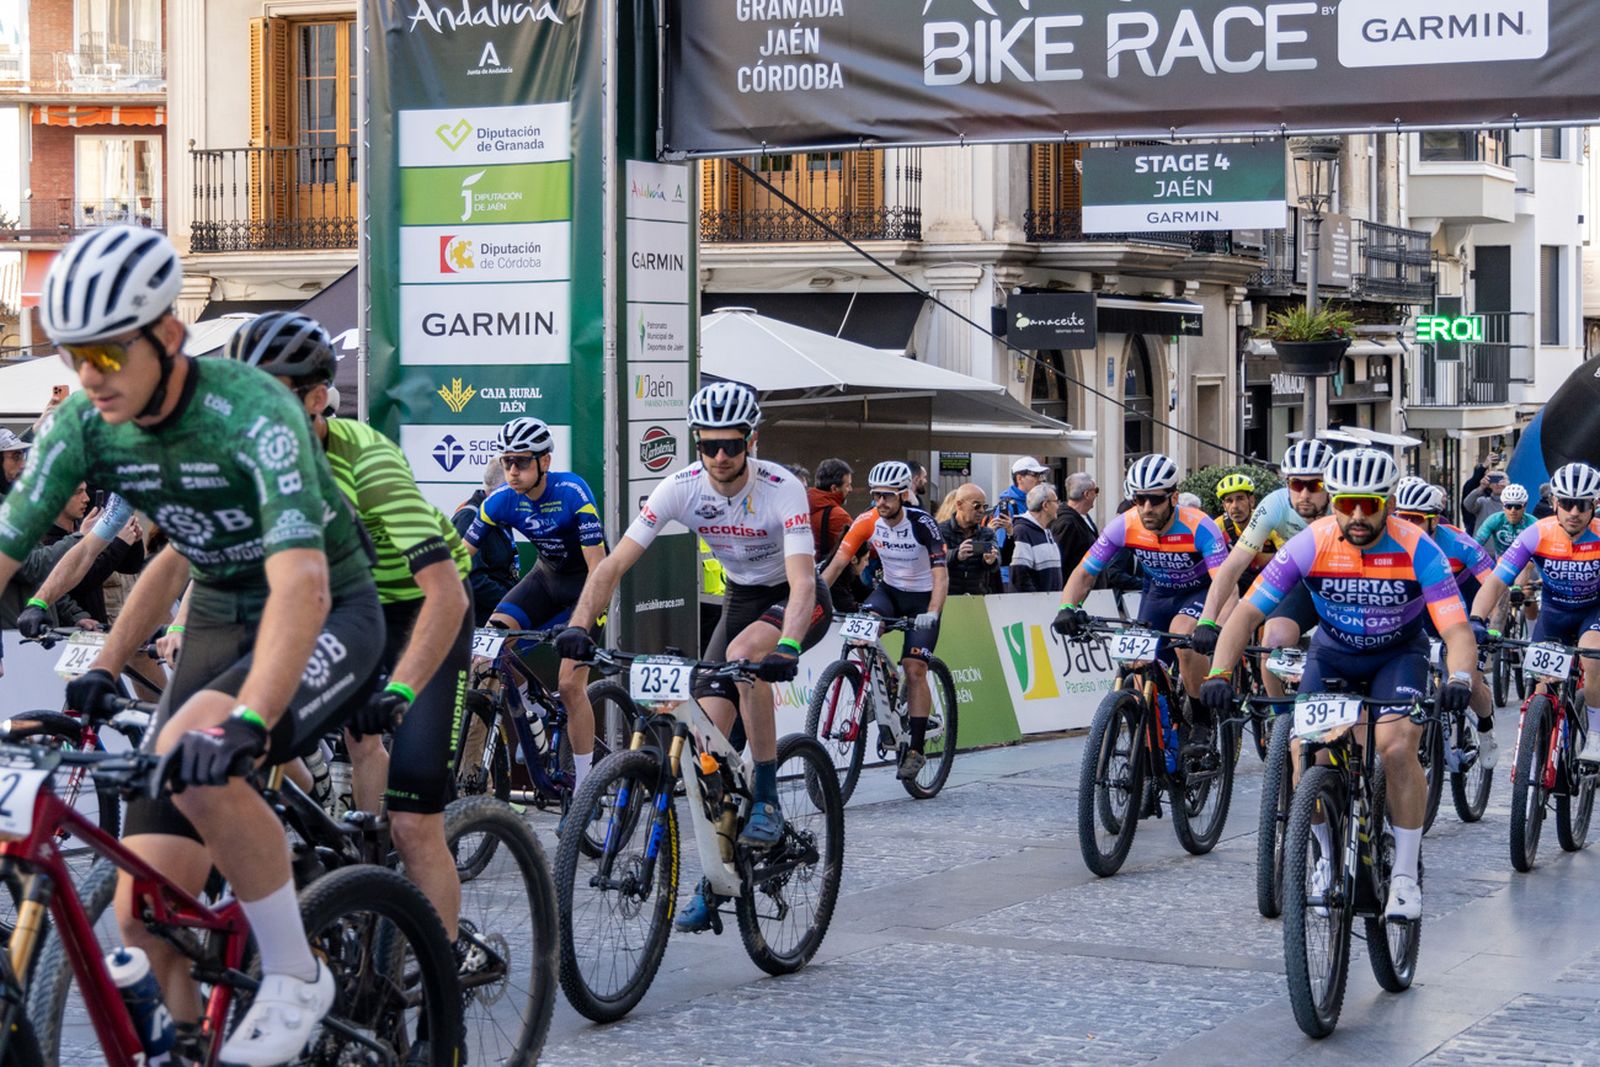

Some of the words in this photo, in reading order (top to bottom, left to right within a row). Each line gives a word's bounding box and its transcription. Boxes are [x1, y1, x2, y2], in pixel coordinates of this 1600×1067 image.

[736, 0, 844, 22] GRANADA
[759, 24, 820, 57] JAÉN
[923, 15, 1084, 86] BIKE
[1106, 3, 1318, 78] RACE
[1321, 6, 1337, 16] BY
[1361, 11, 1525, 44] GARMIN
[736, 60, 844, 94] CÓRDOBA
[477, 125, 541, 140] Diputación
[477, 140, 492, 152] de
[494, 139, 545, 152] Granada
[1135, 153, 1209, 173] STAGE
[1214, 153, 1230, 171] 4
[1153, 176, 1212, 198] JAÉN
[1146, 210, 1220, 224] GARMIN
[480, 241, 542, 255] Diputación
[480, 257, 495, 269] de
[497, 256, 542, 269] Córdoba
[631, 251, 684, 271] GARMIN
[421, 310, 555, 337] GARMIN
[480, 388, 506, 400] CAJA
[509, 387, 542, 399] RURAL
[644, 374, 673, 398] Jaén
[499, 400, 526, 413] JAÉN
[698, 524, 768, 538] ecotisa
[1135, 549, 1190, 562] PUERTAS
[1543, 558, 1600, 573] PUERTAS
[1321, 578, 1406, 595] PUERTAS
[1318, 590, 1409, 607] COFERPU
[846, 620, 874, 637] 35-2
[1118, 636, 1151, 655] 54-2
[1532, 650, 1565, 673] 38-2
[641, 666, 681, 693] 23-2
[449, 670, 467, 751] HENDRIKS
[1305, 702, 1347, 726] 39-1
